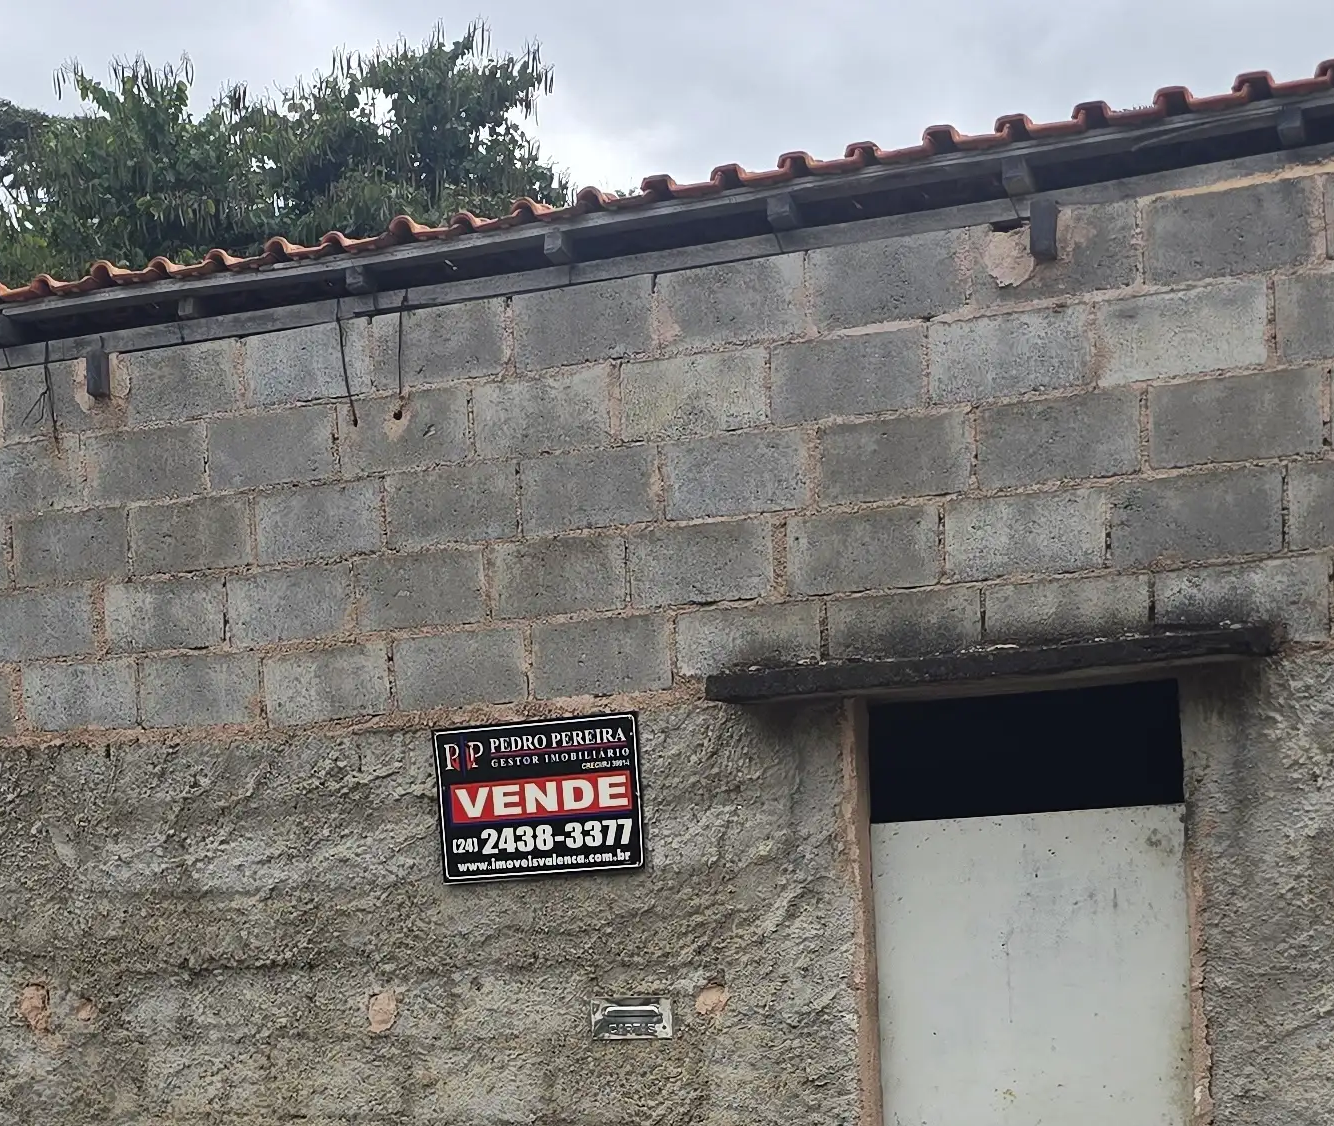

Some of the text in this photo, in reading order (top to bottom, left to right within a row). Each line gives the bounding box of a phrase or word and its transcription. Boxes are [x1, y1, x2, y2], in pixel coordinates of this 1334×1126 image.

[489, 727, 627, 753] PEDRO PEREIRA
[490, 747, 630, 768] GESTOR IMOBILIÁRIO
[454, 775, 629, 818] VENDE
[452, 818, 633, 855] (24) 2438-3377
[457, 849, 631, 873] www.imoveisvalenca.com.br
